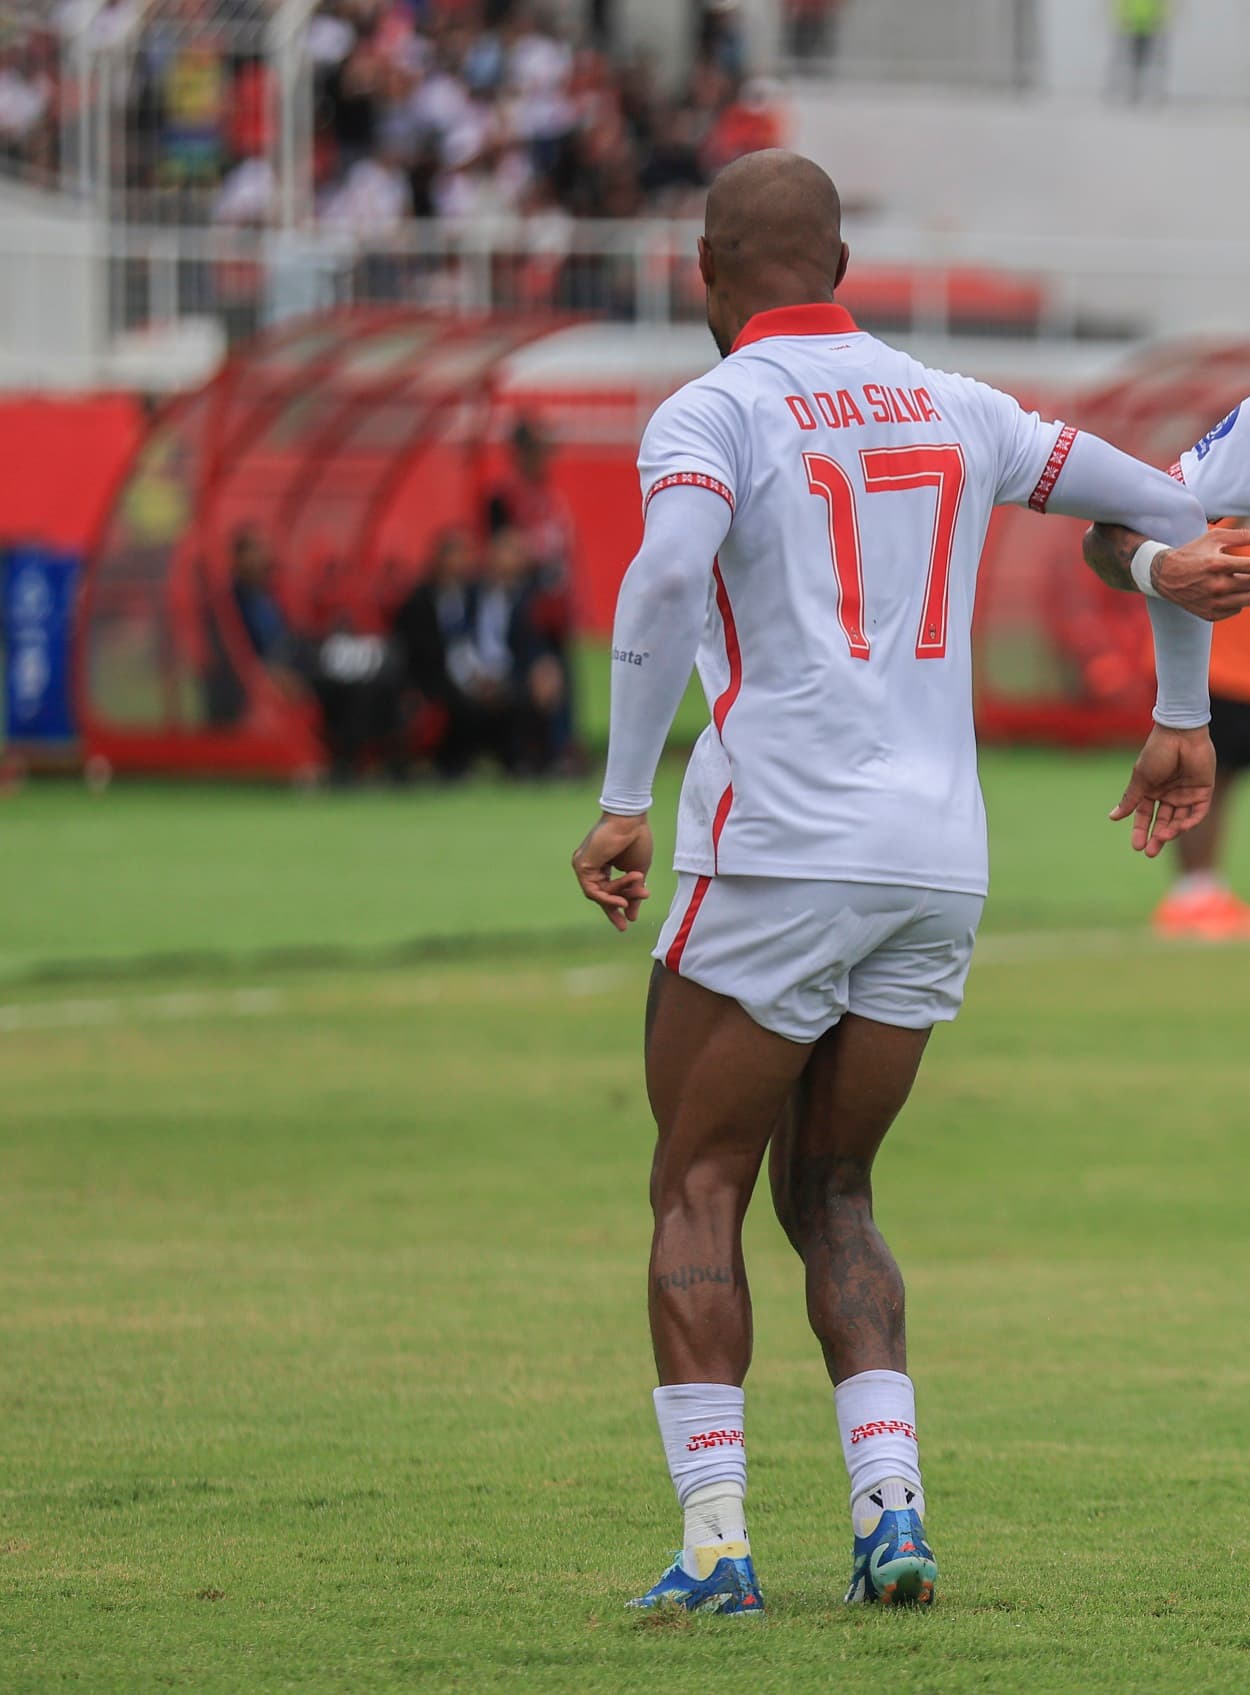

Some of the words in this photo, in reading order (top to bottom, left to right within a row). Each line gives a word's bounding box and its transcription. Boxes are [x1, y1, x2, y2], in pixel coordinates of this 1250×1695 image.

[784, 395, 817, 430] D
[813, 389, 866, 429] DA
[862, 383, 942, 424] SILVA
[801, 443, 967, 661] 17
[689, 1429, 745, 1443] MALU
